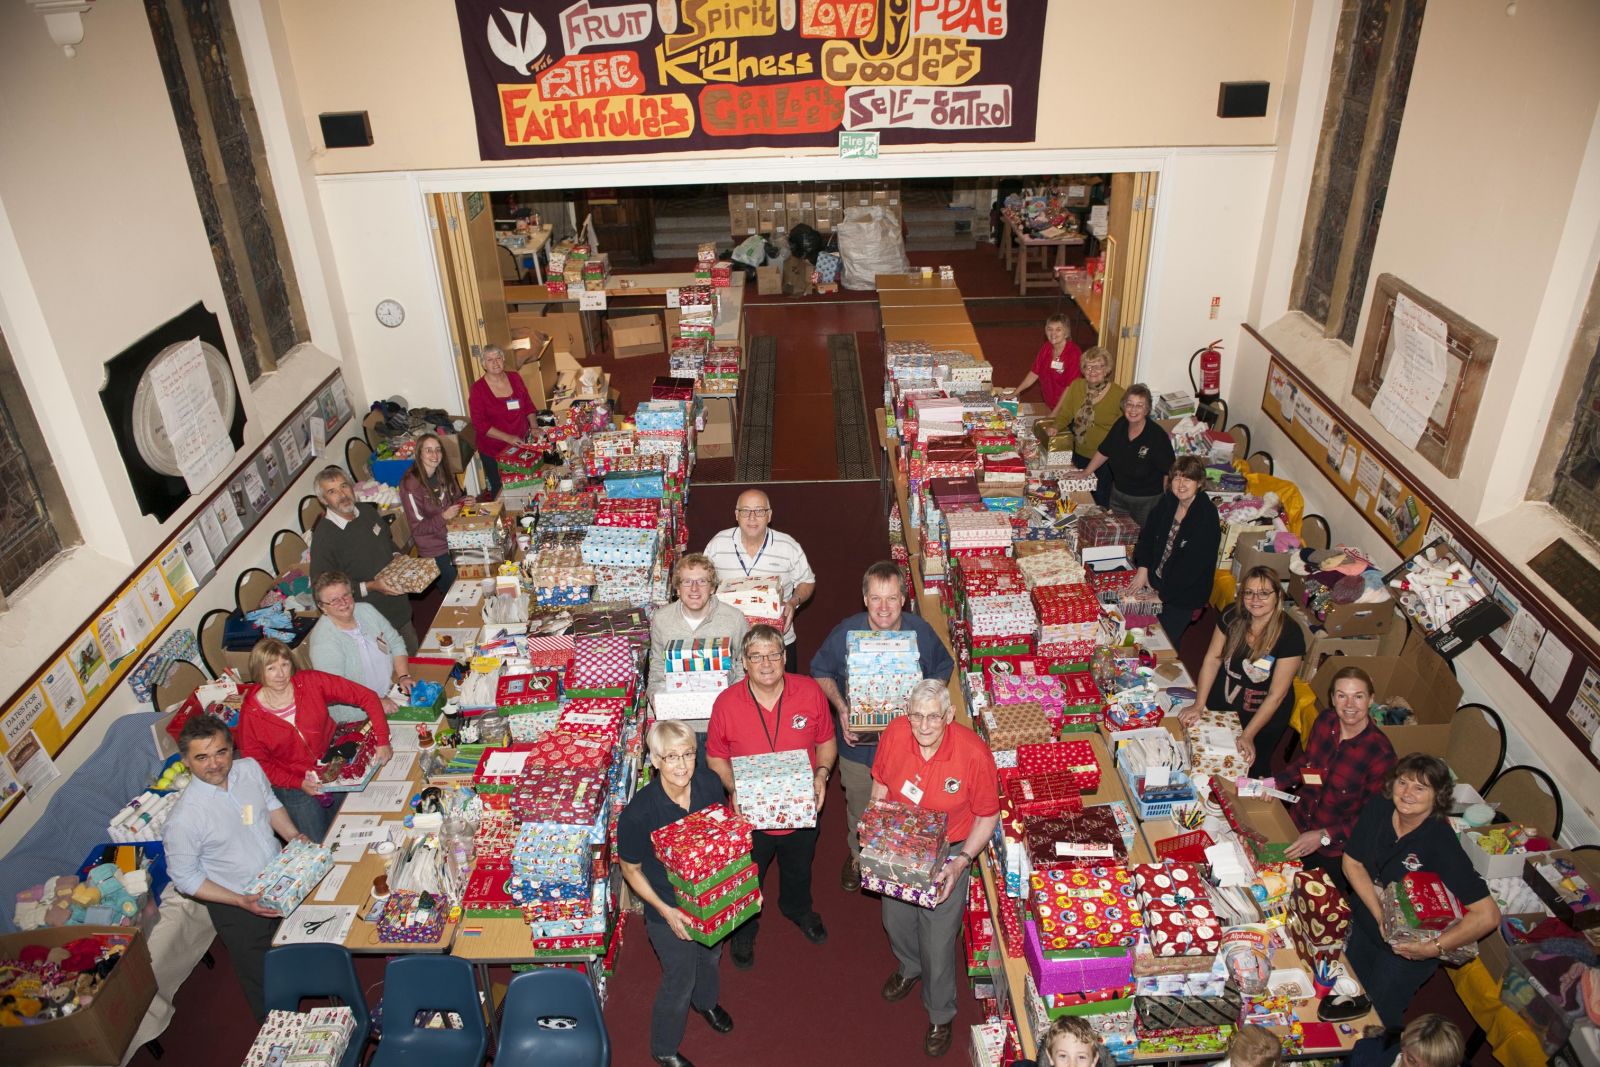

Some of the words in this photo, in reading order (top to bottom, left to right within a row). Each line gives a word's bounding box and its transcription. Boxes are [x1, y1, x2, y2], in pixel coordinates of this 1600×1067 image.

[565, 3, 647, 50] FRUIT
[654, 40, 814, 86] Kindness
[8, 719, 27, 739] YOUR
[25, 702, 43, 721] DIARY
[1231, 932, 1262, 941] Alphabet
